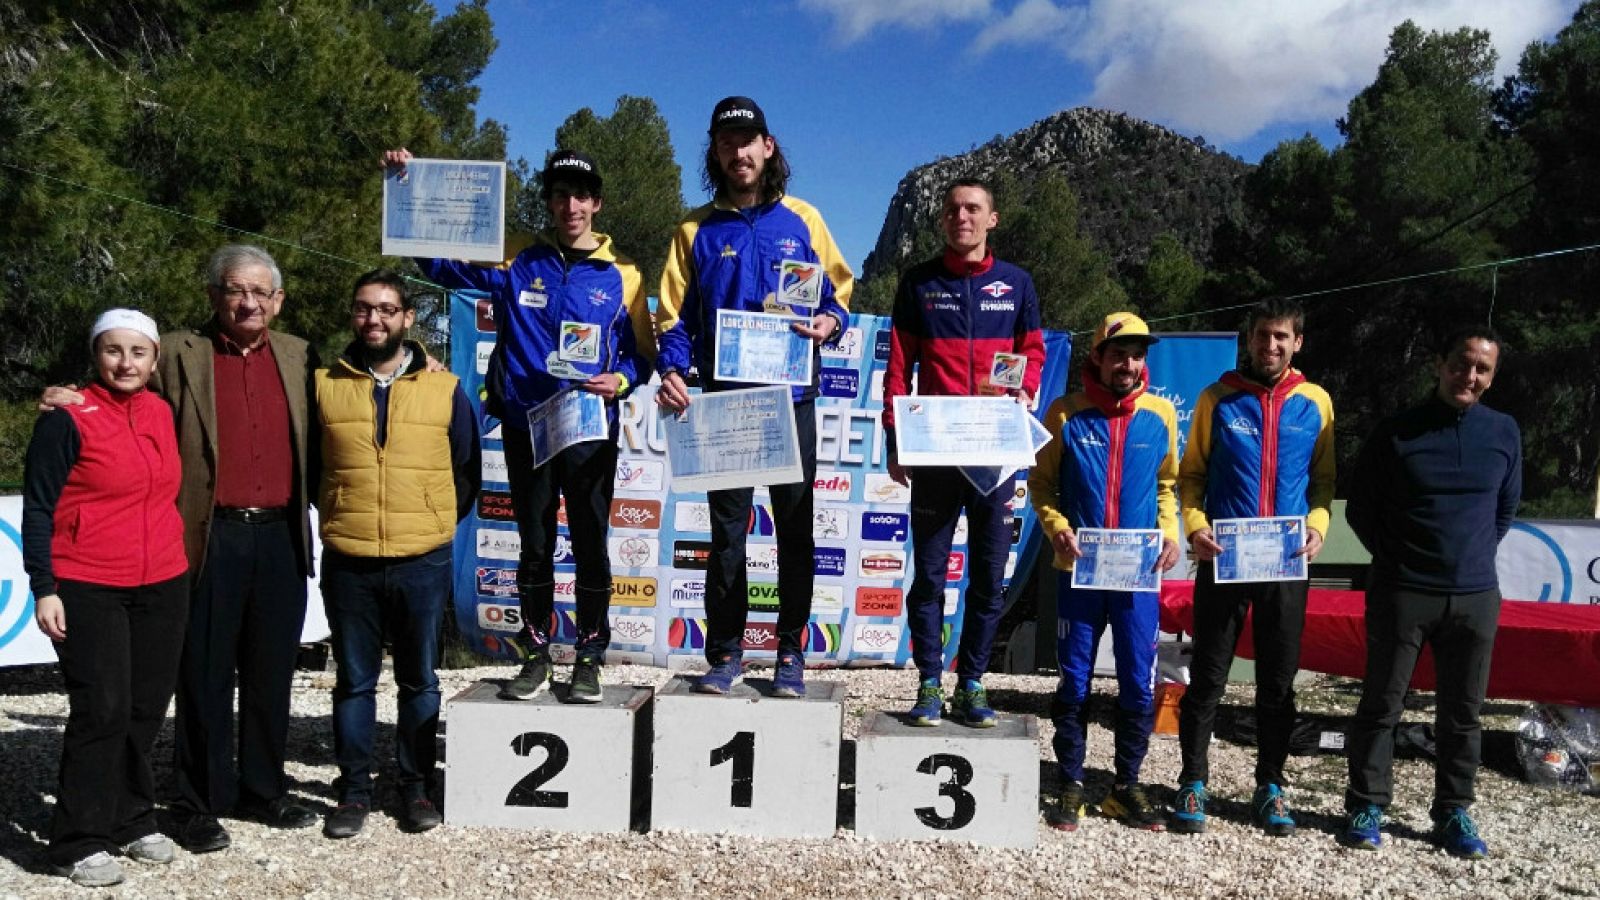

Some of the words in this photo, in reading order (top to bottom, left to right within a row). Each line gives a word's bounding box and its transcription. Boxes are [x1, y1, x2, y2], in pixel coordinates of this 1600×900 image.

[862, 602, 898, 610] ZONE
[505, 731, 569, 808] 2
[710, 731, 755, 808] 1
[914, 752, 977, 831] 3
